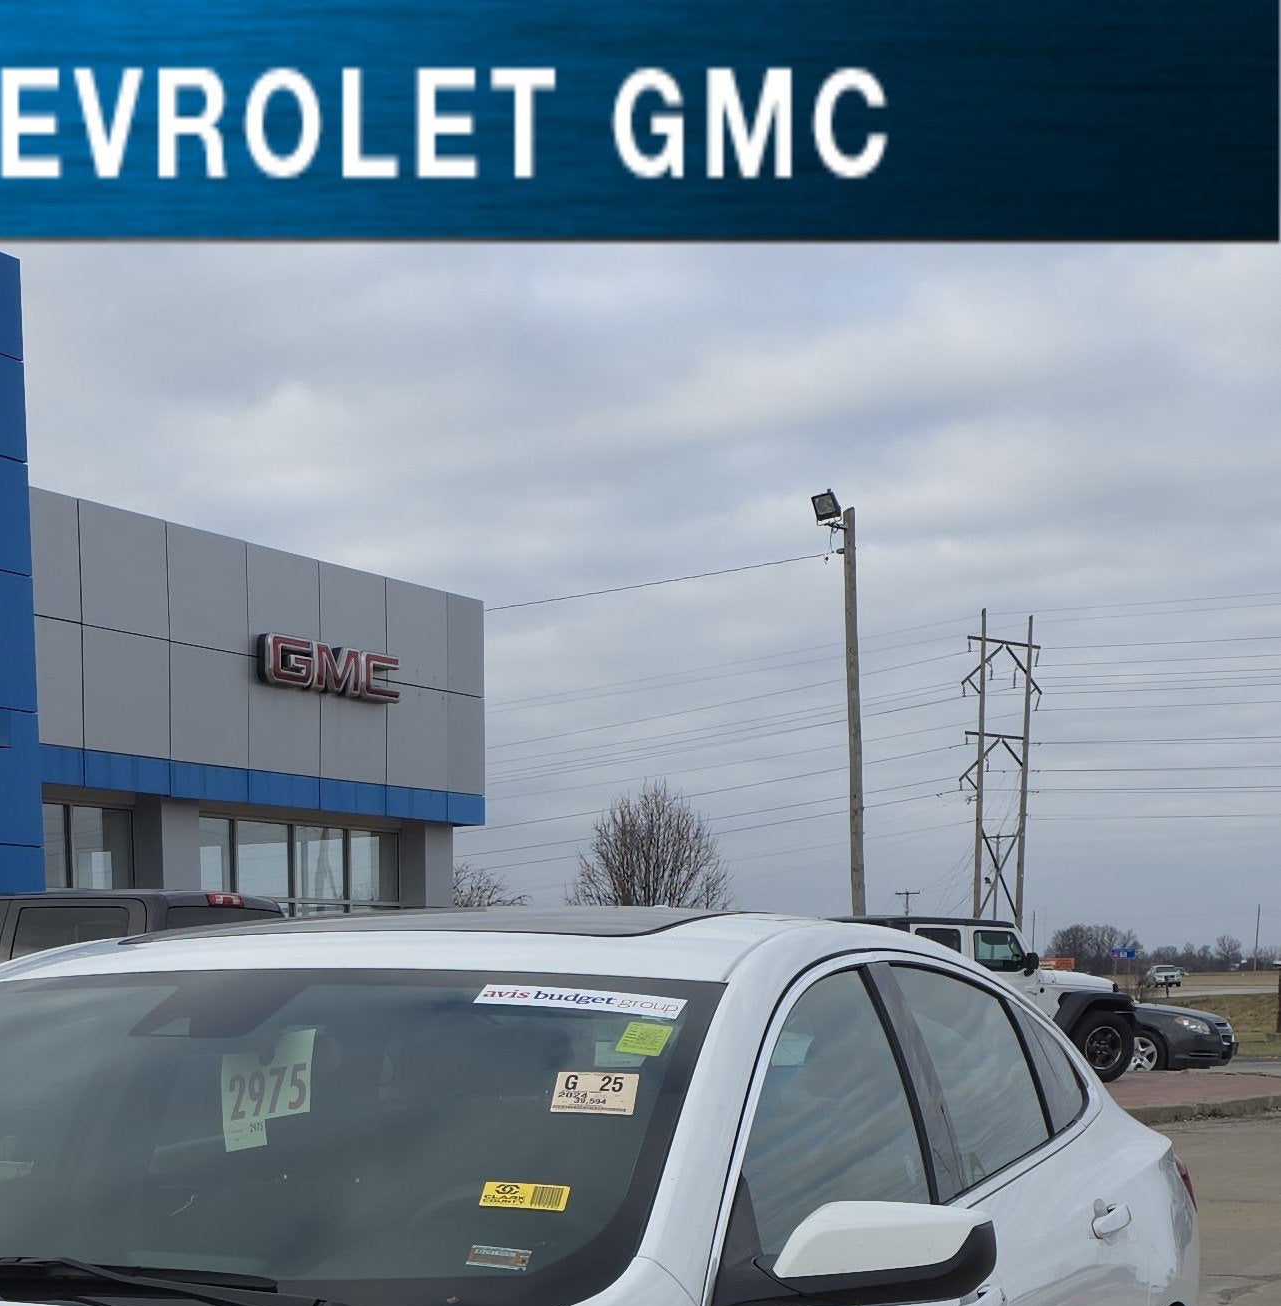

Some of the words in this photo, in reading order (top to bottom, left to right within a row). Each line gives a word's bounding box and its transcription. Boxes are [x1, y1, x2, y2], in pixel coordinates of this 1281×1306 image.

[260, 631, 401, 704] GMC
[482, 988, 530, 1000] avis
[533, 990, 618, 1005] budget
[617, 998, 679, 1014] group
[229, 1062, 307, 1121] 2975
[564, 1074, 579, 1091] G
[599, 1075, 624, 1093] 25
